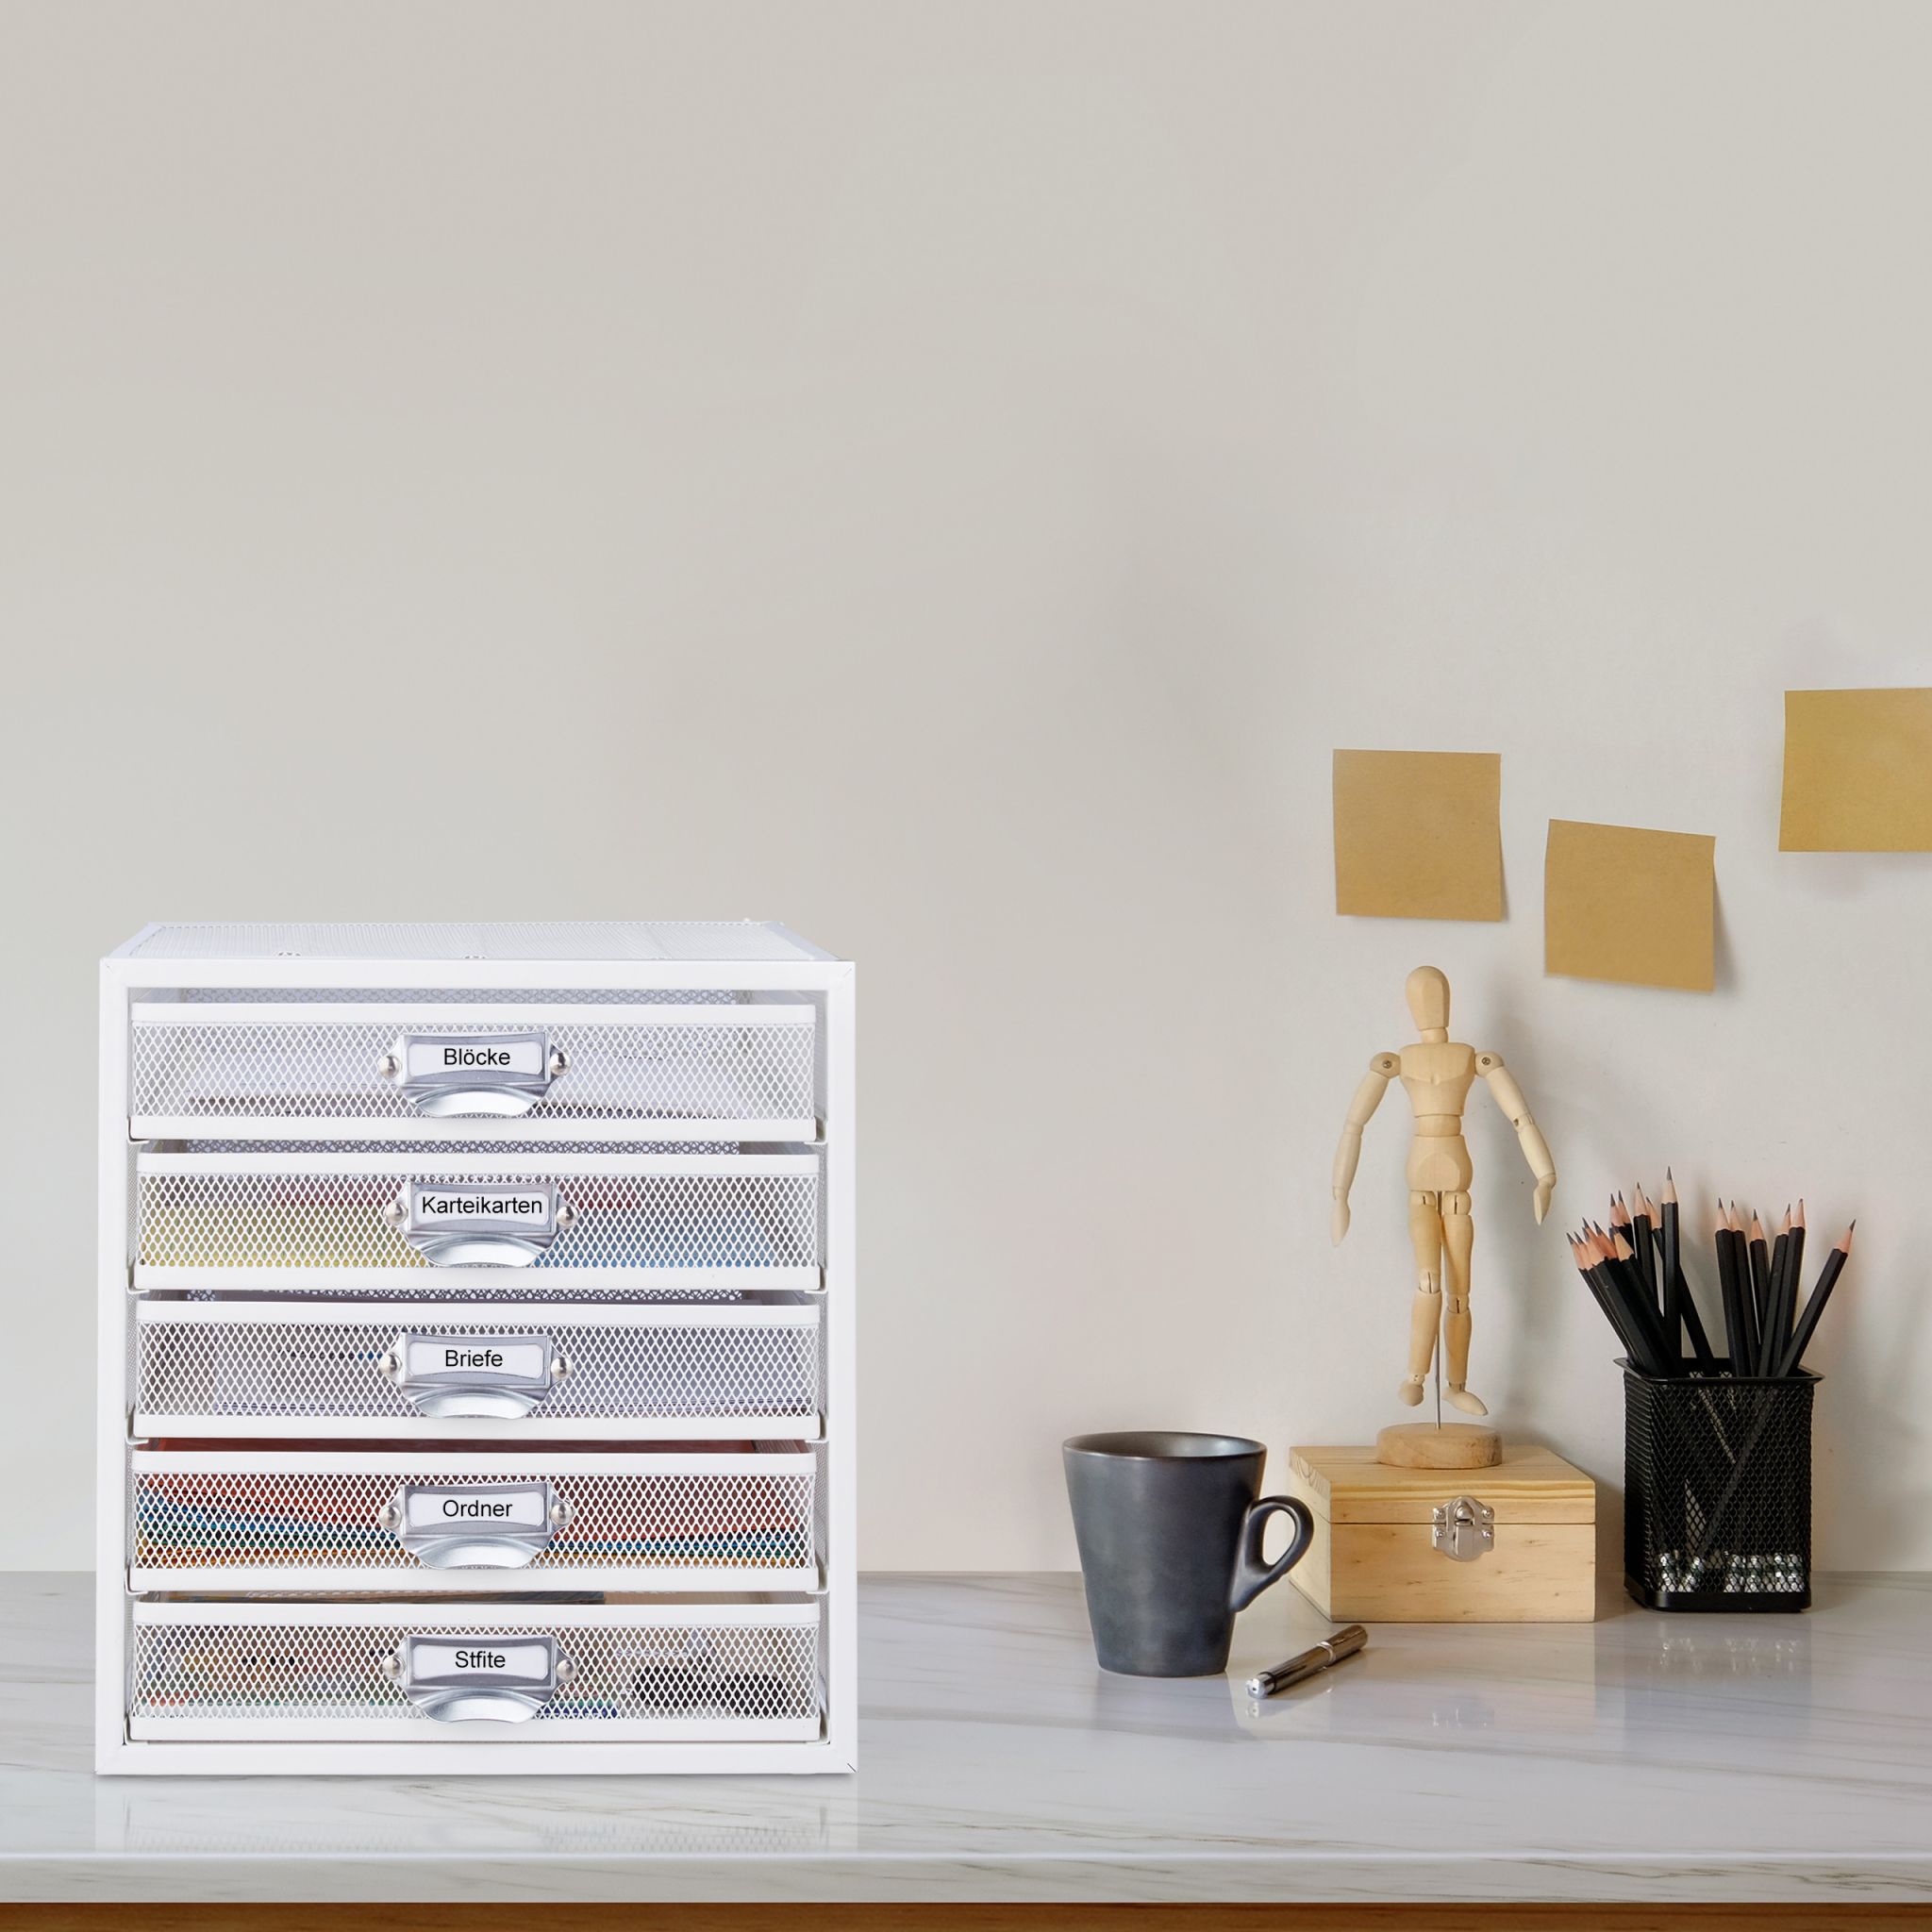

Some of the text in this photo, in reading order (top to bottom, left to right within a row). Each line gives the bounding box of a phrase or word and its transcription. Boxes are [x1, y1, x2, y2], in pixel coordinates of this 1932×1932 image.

[443, 1047, 510, 1066] Blöcke
[422, 1196, 542, 1214] Karteikarten
[445, 1349, 504, 1368] Briefe
[442, 1499, 513, 1518] Ordner
[455, 1650, 506, 1669] Stfite
